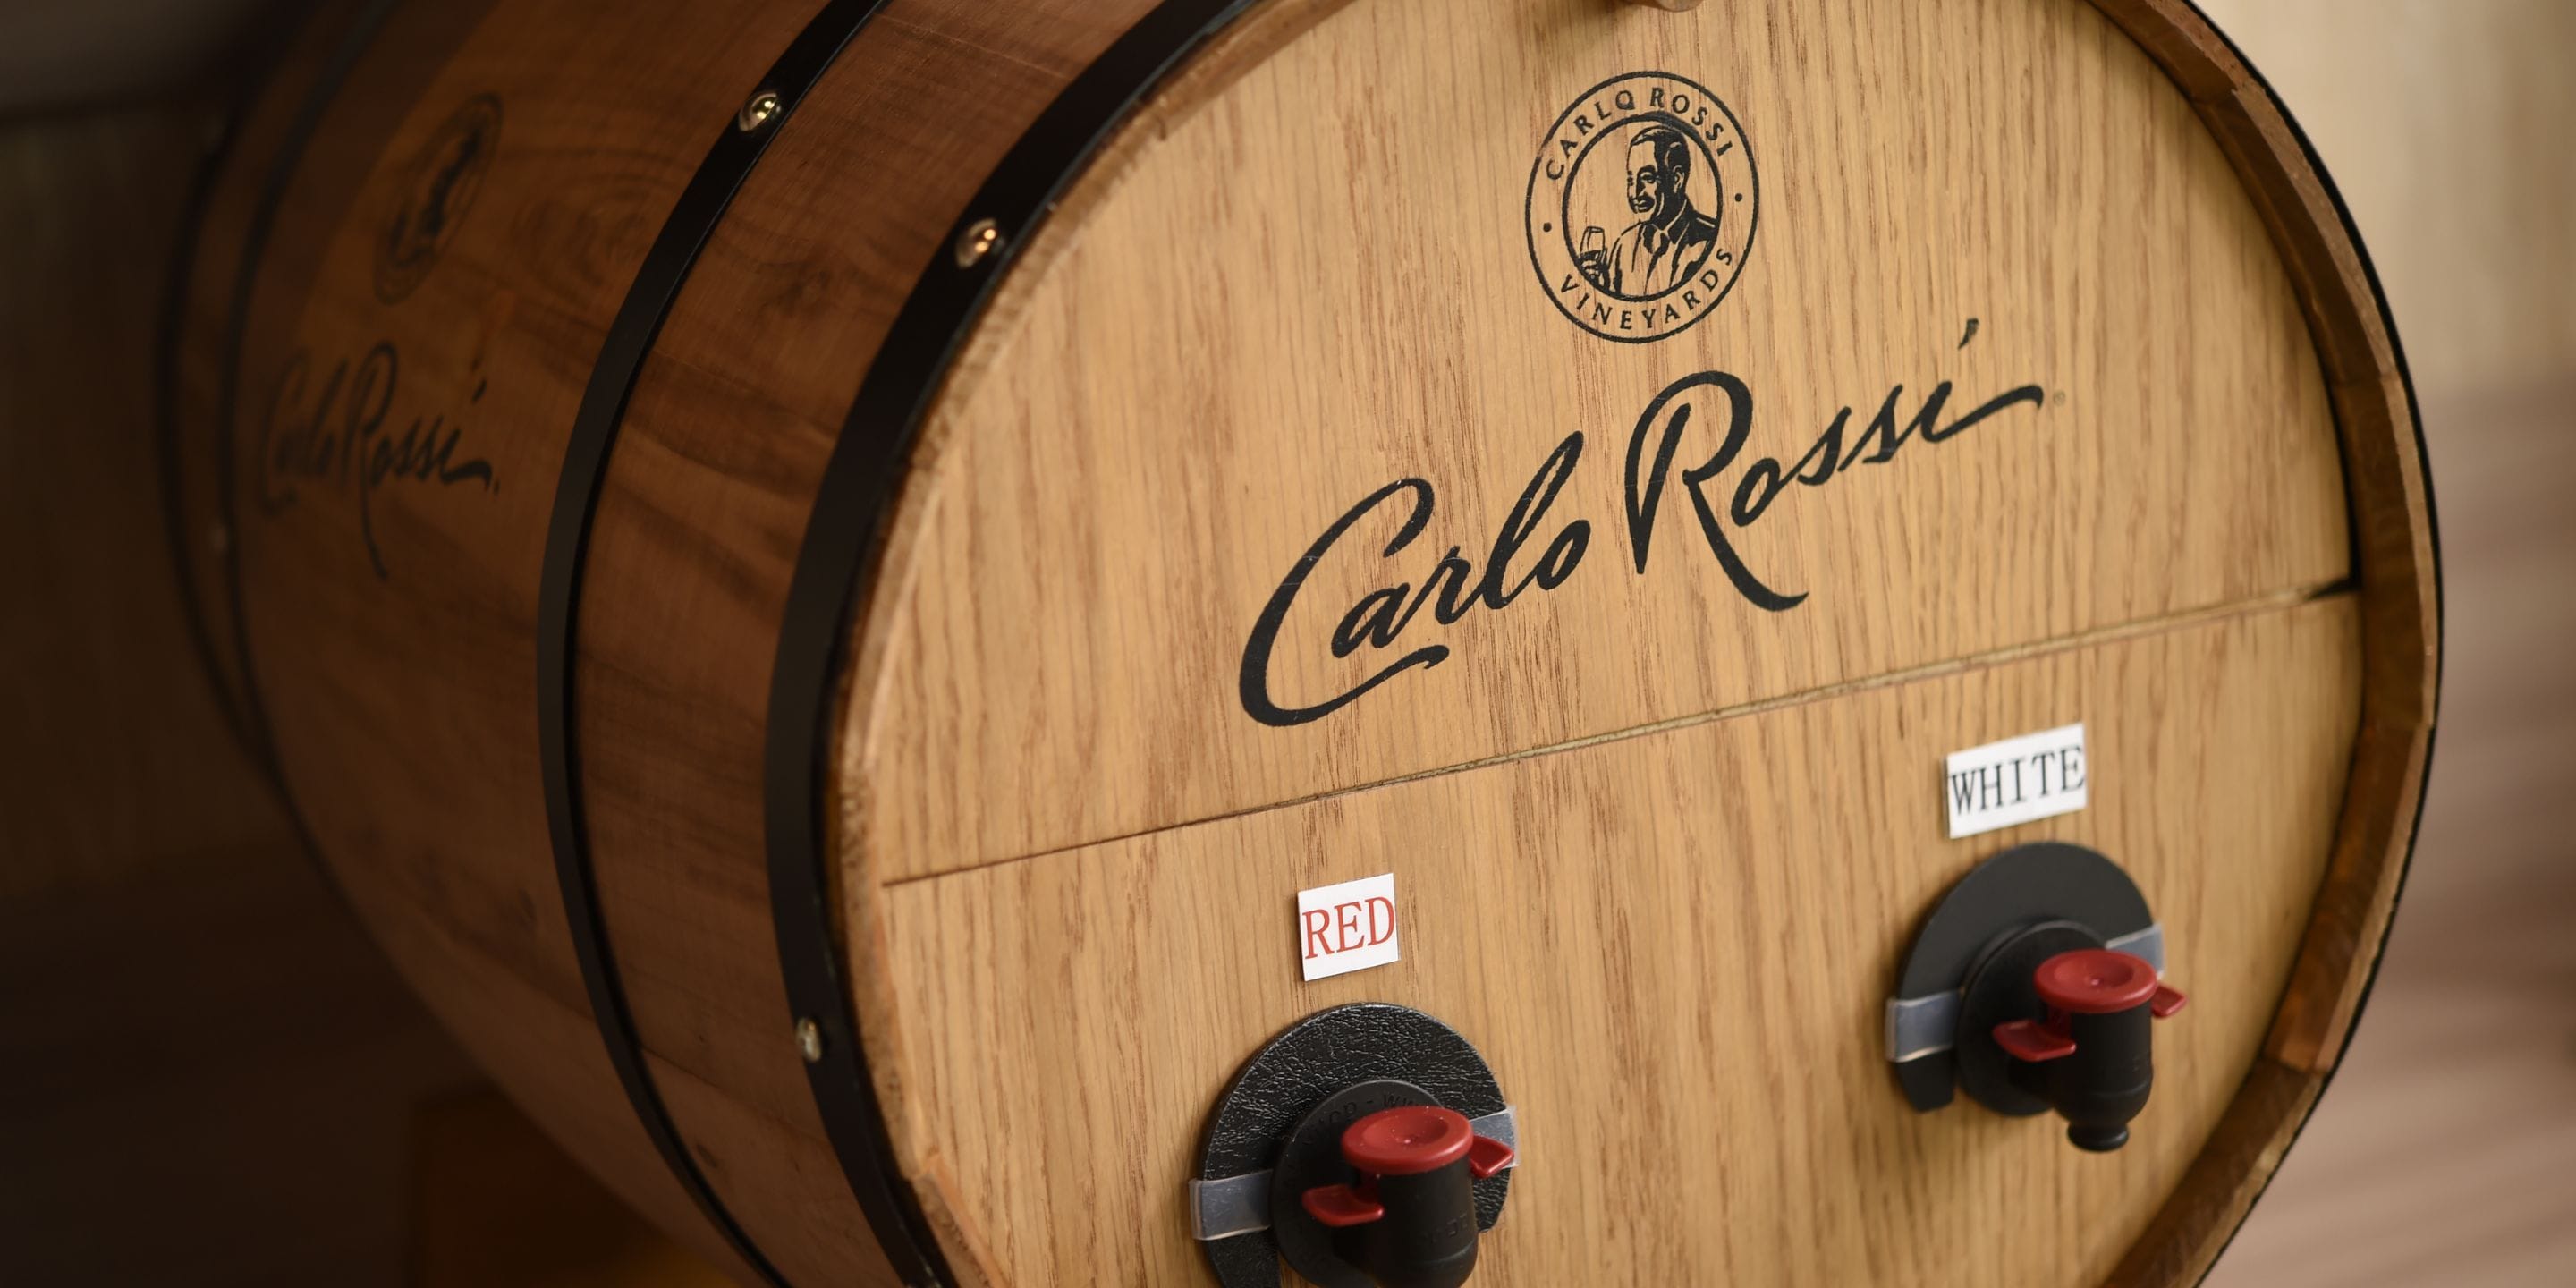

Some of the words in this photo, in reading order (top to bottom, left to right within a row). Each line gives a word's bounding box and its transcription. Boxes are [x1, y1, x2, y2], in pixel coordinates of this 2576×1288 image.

[1649, 87, 1733, 157] ROSSI
[1560, 247, 1733, 331] VINEYARDS
[1239, 431, 1590, 728] Carlo
[1624, 318, 2044, 612] Rossi
[1948, 744, 2085, 816] WHITE
[1301, 896, 1394, 960] RED
